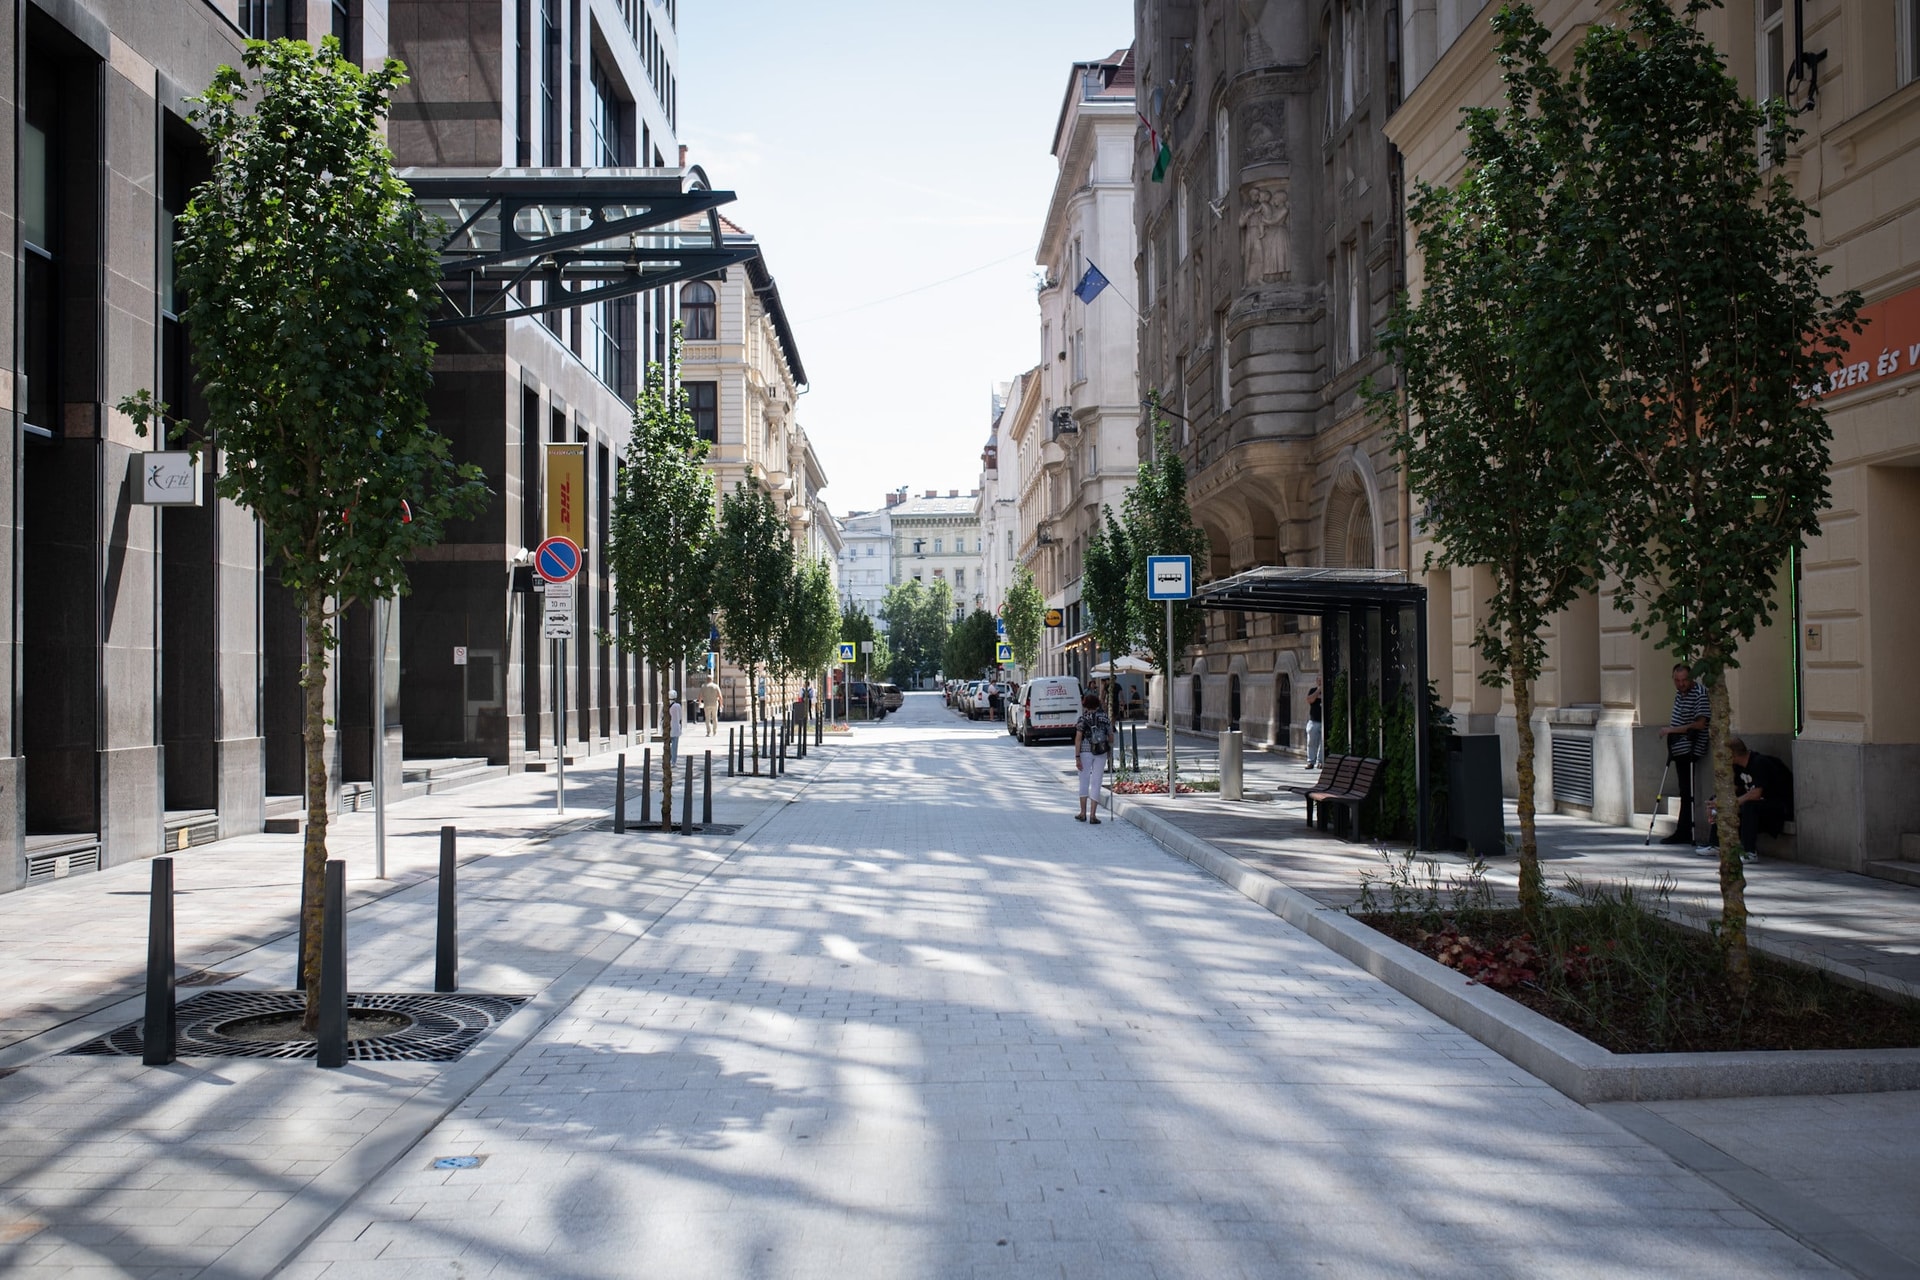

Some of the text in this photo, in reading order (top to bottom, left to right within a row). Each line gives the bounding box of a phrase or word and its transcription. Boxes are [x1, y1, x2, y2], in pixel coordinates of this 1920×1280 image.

[1877, 347, 1900, 376] ÉS
[165, 471, 190, 488] Fit
[561, 481, 570, 524] DHL
